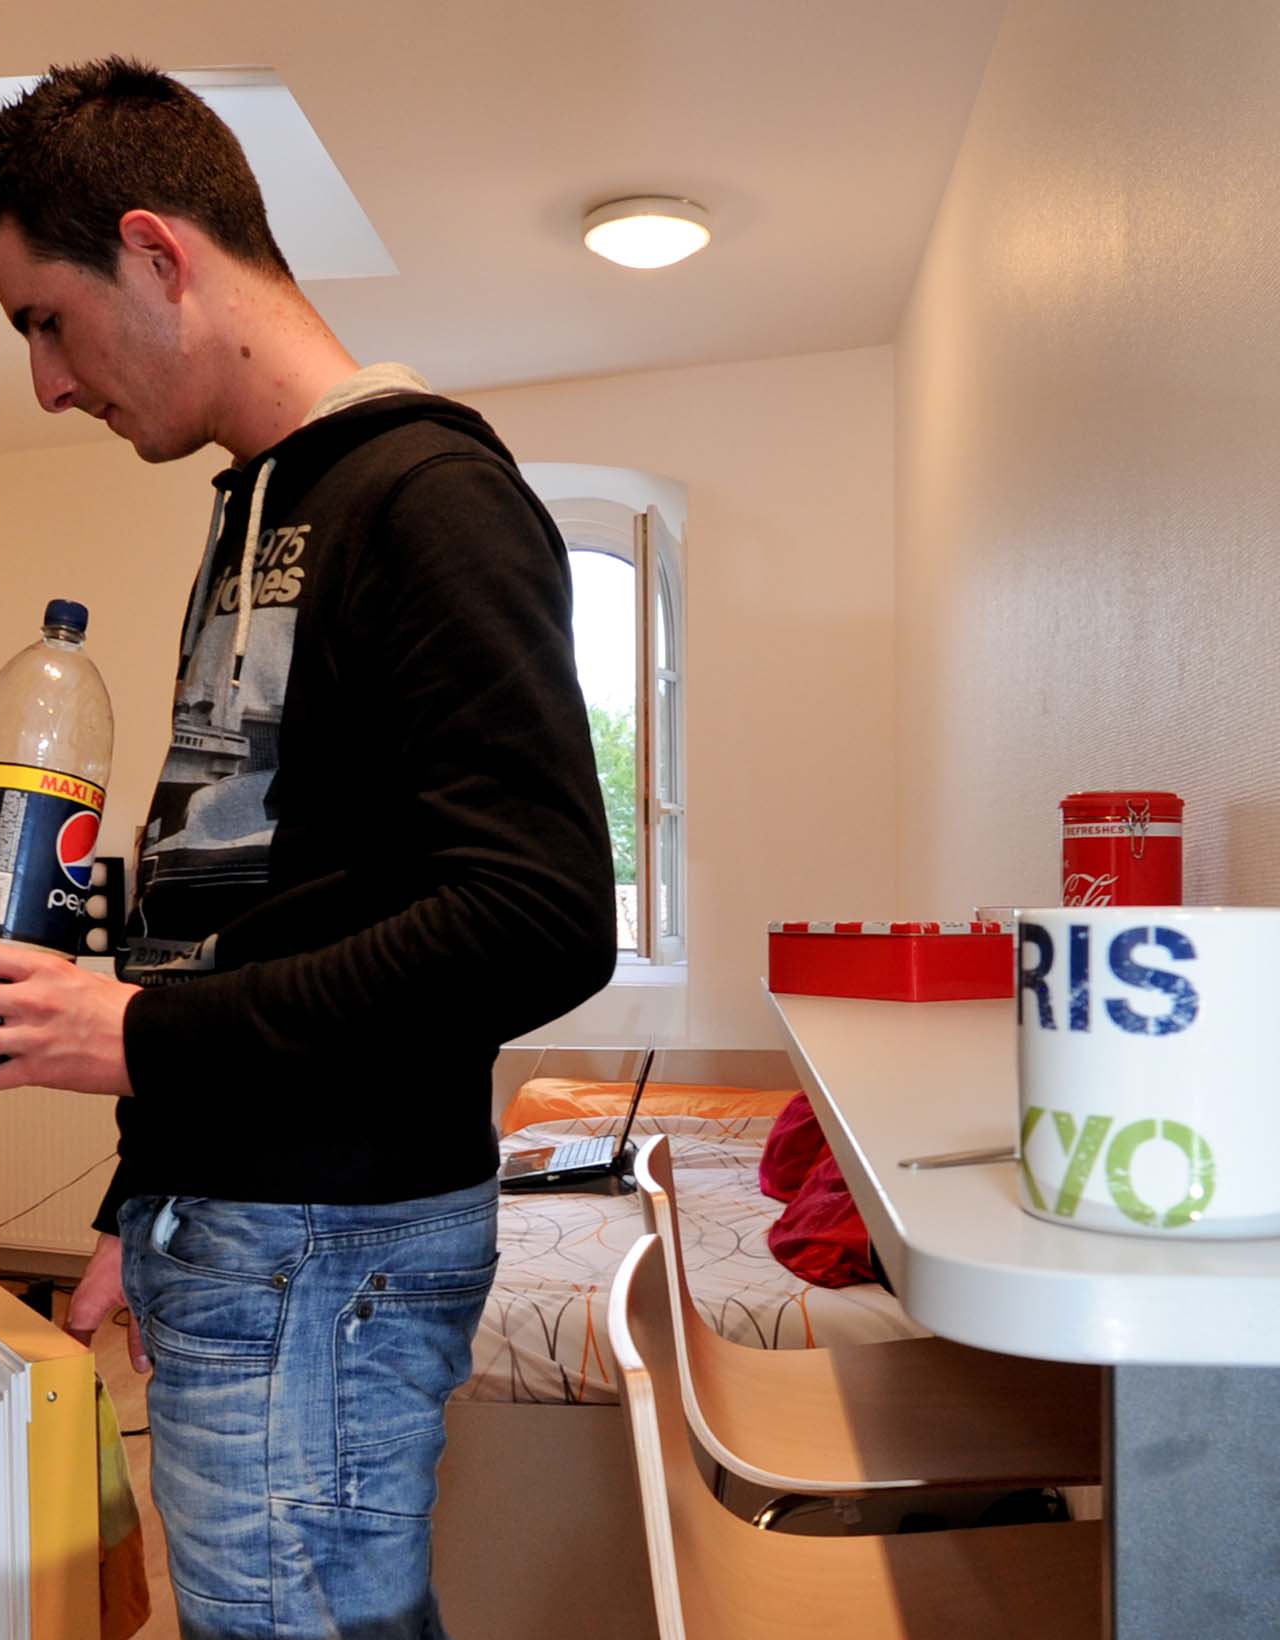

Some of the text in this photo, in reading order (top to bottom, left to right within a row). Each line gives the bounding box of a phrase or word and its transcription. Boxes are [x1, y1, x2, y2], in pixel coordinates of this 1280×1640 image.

[255, 524, 312, 567] 975
[40, 775, 88, 801] MAXI
[1018, 922, 1199, 1036] RIS
[1021, 1105, 1216, 1228] KYO
